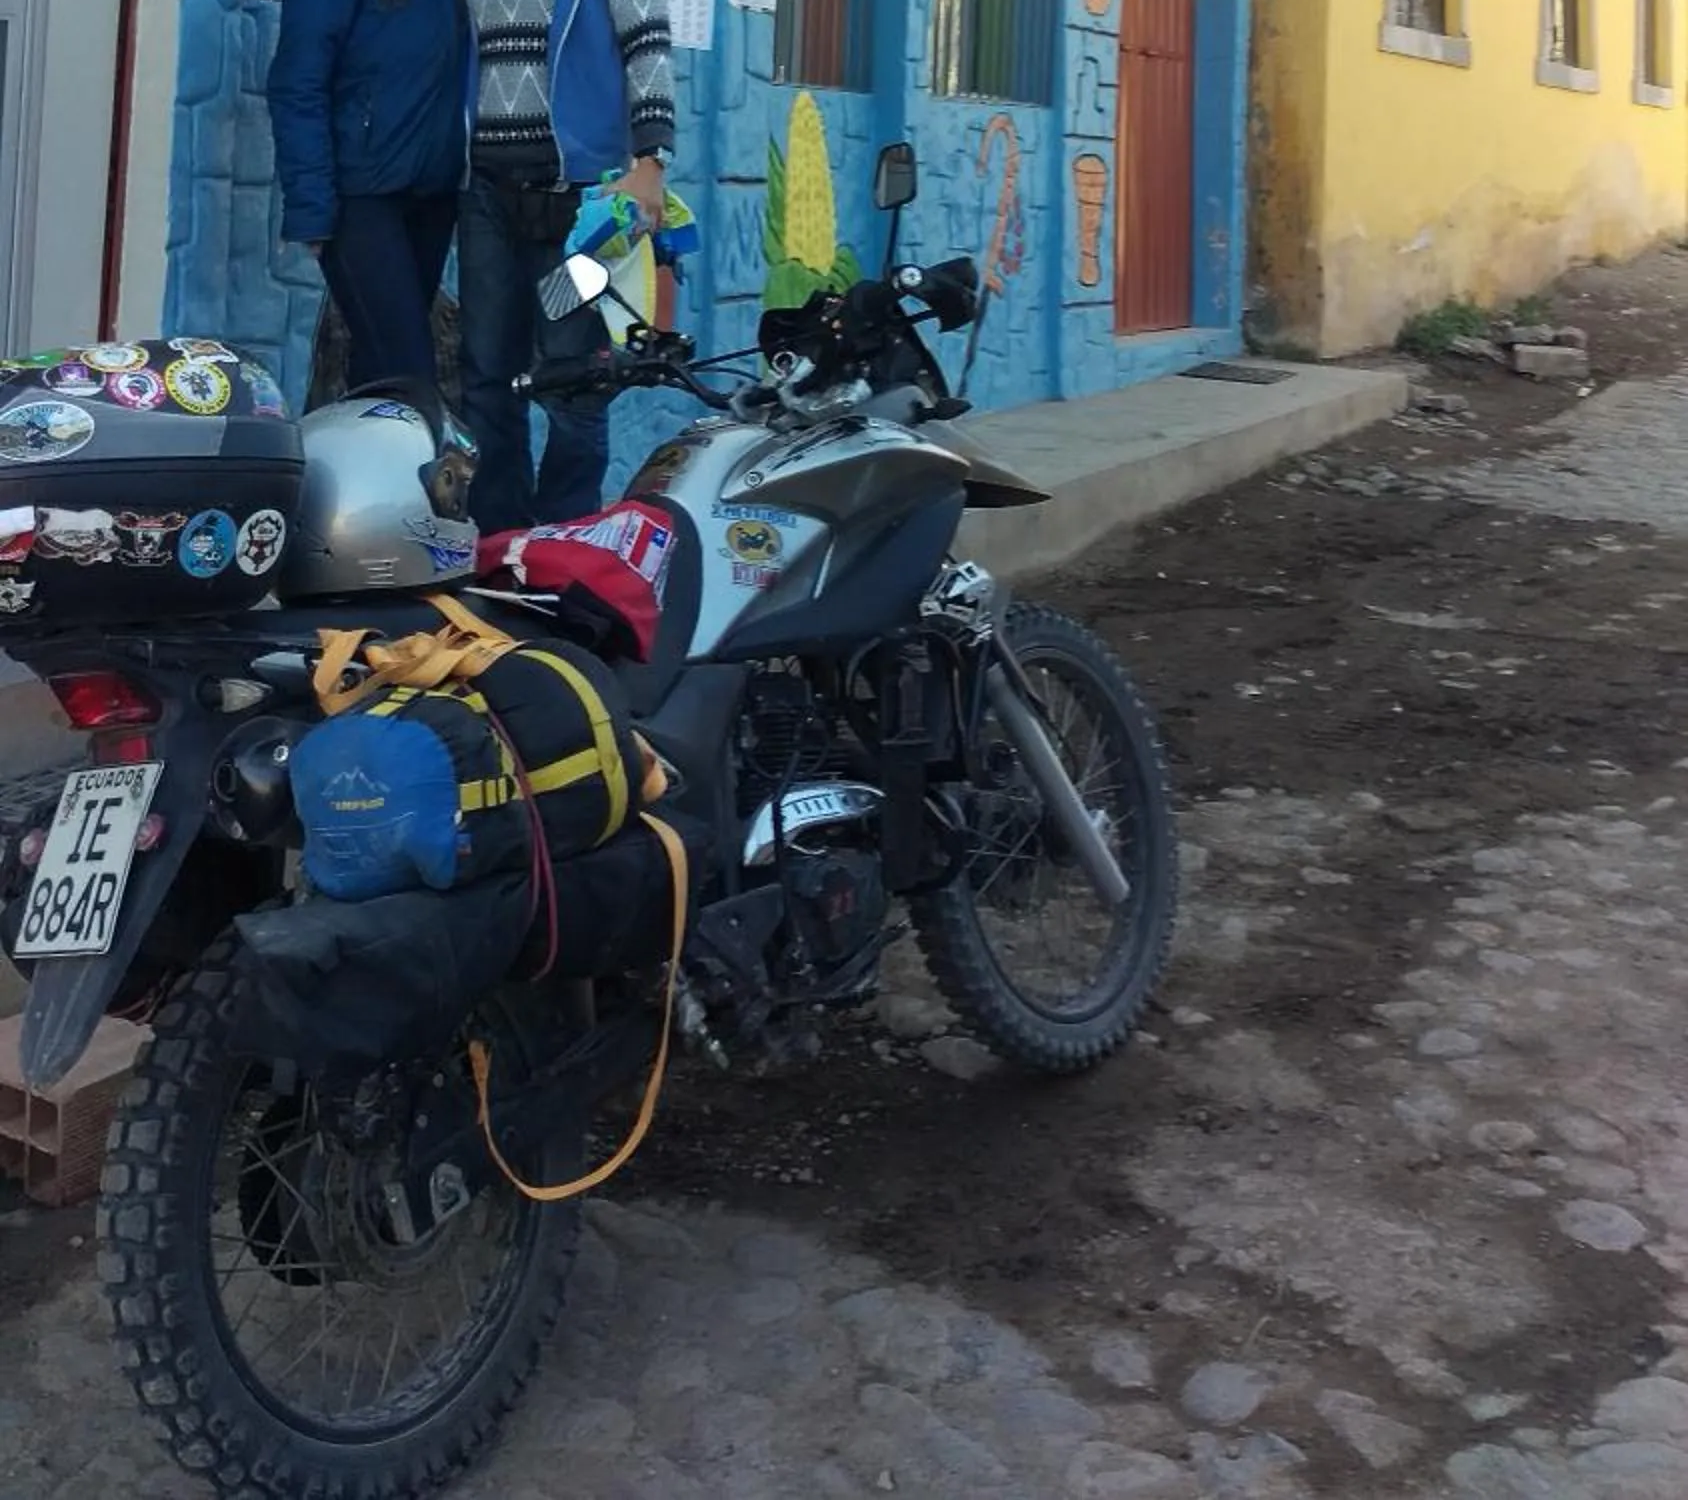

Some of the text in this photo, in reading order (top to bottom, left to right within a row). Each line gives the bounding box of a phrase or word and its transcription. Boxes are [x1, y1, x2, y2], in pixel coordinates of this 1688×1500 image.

[75, 767, 147, 793] ECUADOR
[66, 797, 124, 865] IE
[24, 872, 118, 943] 884R
